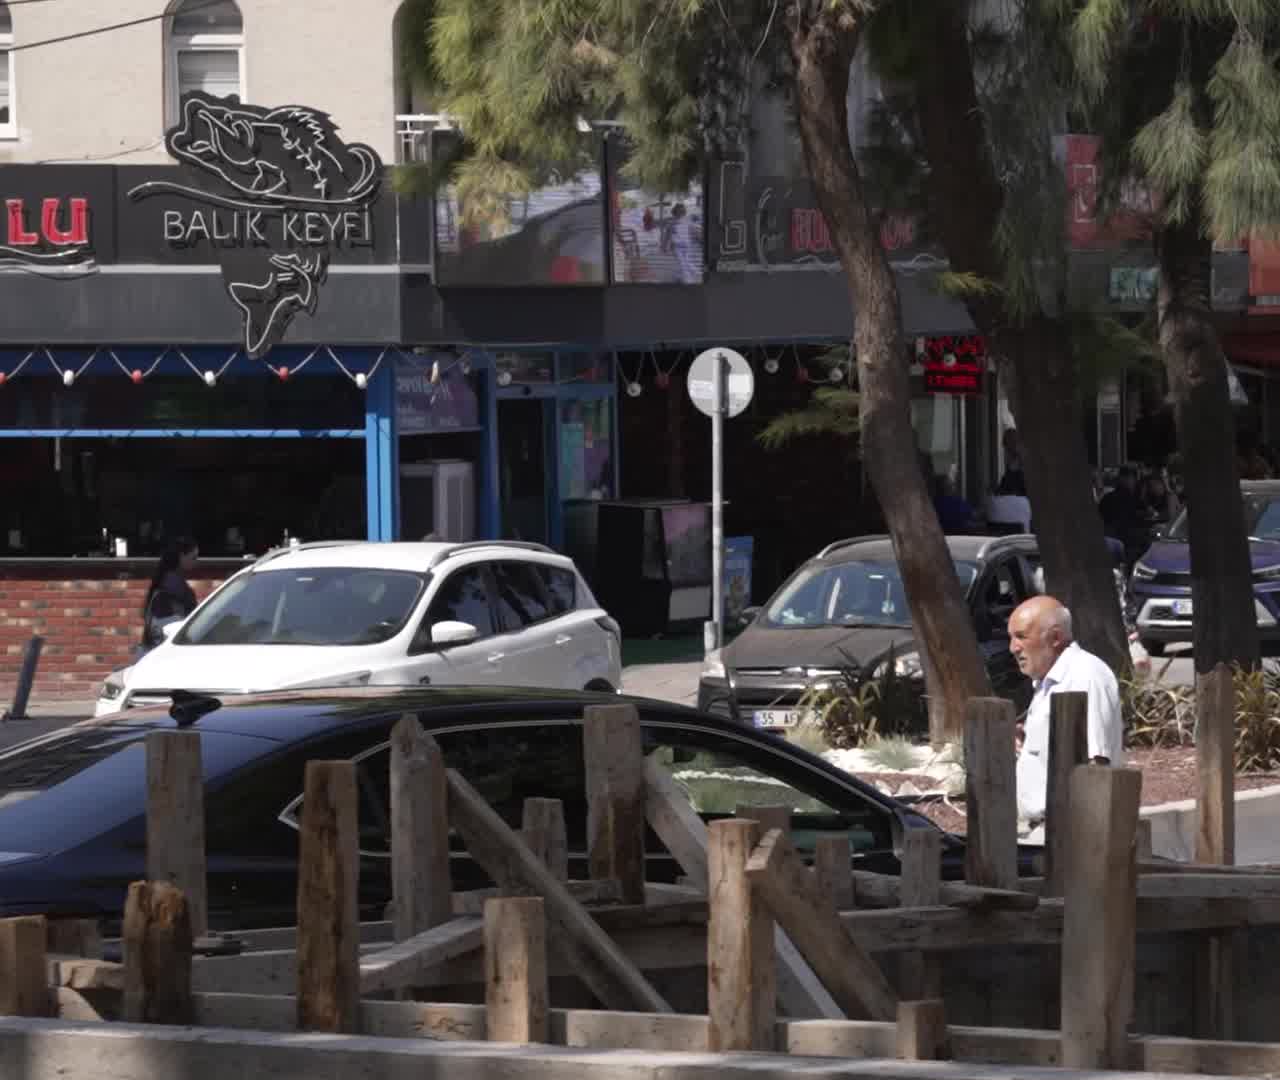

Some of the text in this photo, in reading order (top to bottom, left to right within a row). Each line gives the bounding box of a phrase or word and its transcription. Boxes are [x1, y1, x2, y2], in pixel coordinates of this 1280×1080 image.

[7, 198, 88, 245] LU
[163, 203, 370, 242] BALIK KEYFİ
